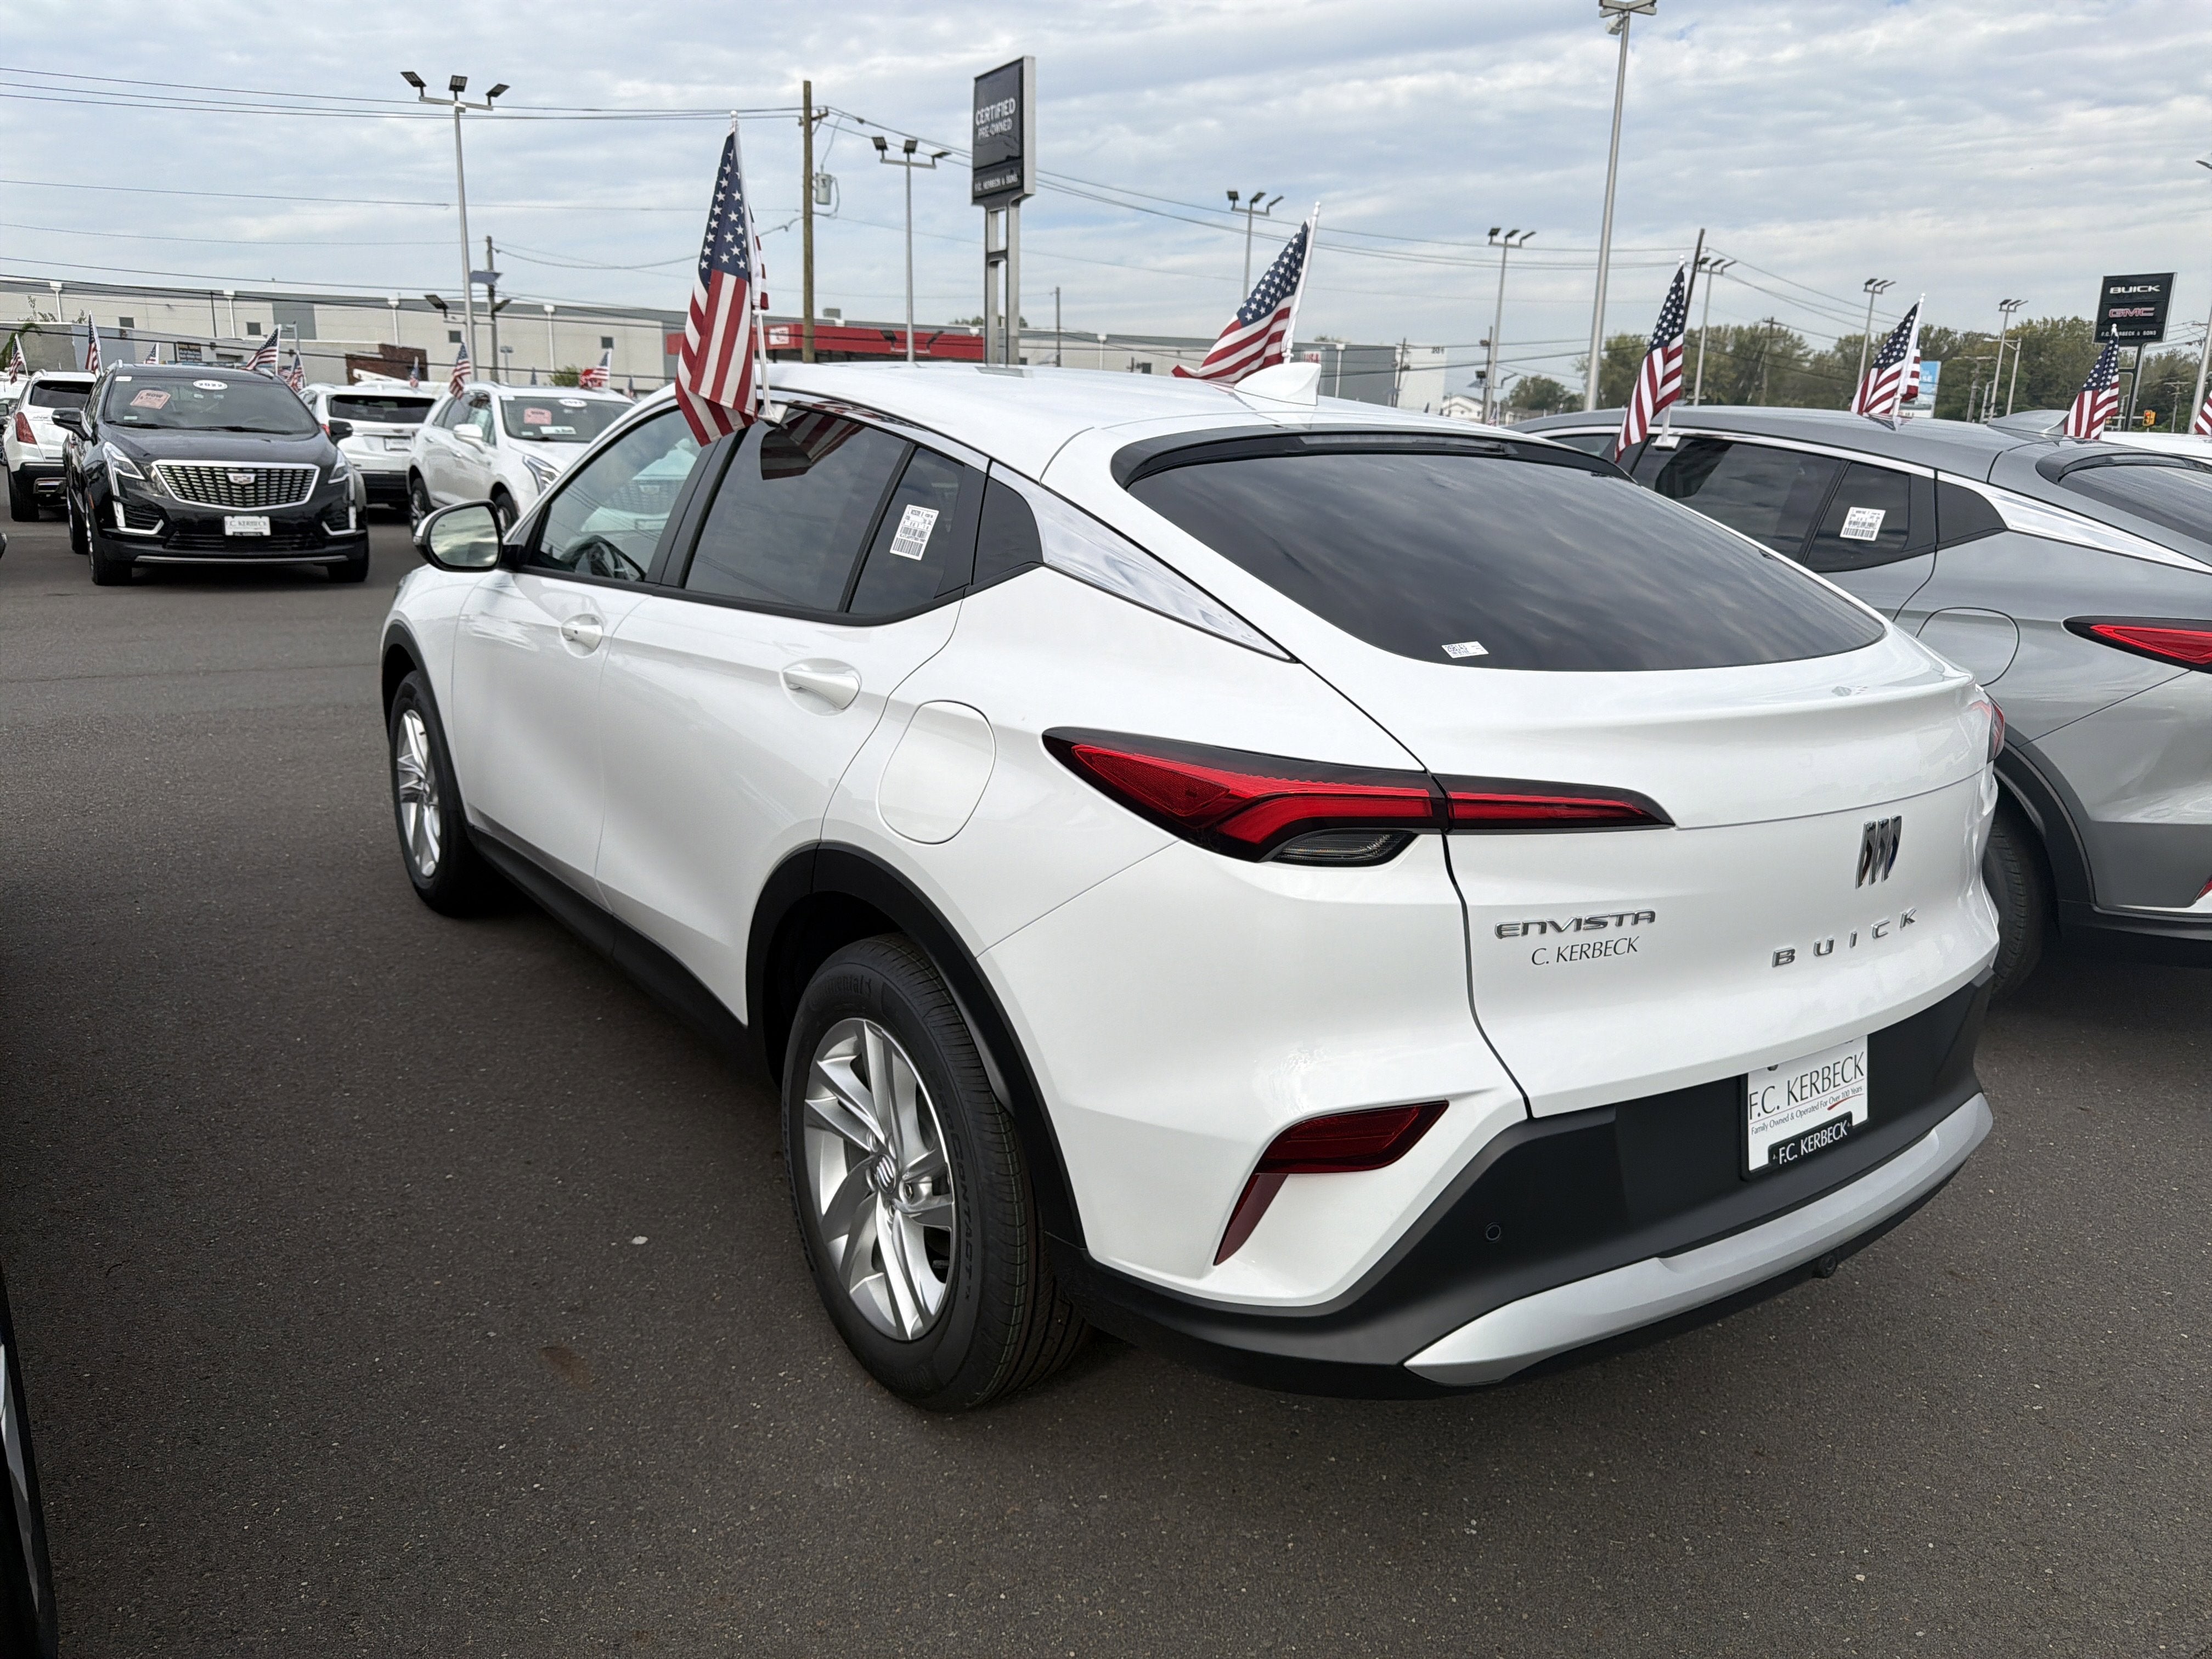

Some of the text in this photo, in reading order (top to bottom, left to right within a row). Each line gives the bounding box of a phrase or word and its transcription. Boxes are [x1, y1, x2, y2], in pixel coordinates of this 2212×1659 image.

[975, 98, 1016, 126] CERTIFIED
[978, 117, 1013, 139] PRE-OWNED
[2109, 285, 2160, 294] BUICK
[2109, 307, 2155, 318] GMC
[1494, 909, 1656, 939] ENVISTA
[1771, 907, 1917, 968] BUICK
[1531, 936, 1640, 966] C. KERBECK
[1749, 1052, 1864, 1120] F.C. KERBECK
[1751, 1122, 1768, 1136] Family
[1769, 1114, 1789, 1128] Owned
[1796, 1102, 1819, 1119] Operated
[1820, 1099, 1828, 1109] For
[1829, 1095, 1841, 1105] Over
[1842, 1090, 1850, 1098] 100
[1850, 1086, 1863, 1095] Years
[1779, 1120, 1848, 1165] F.C. KERBECK
